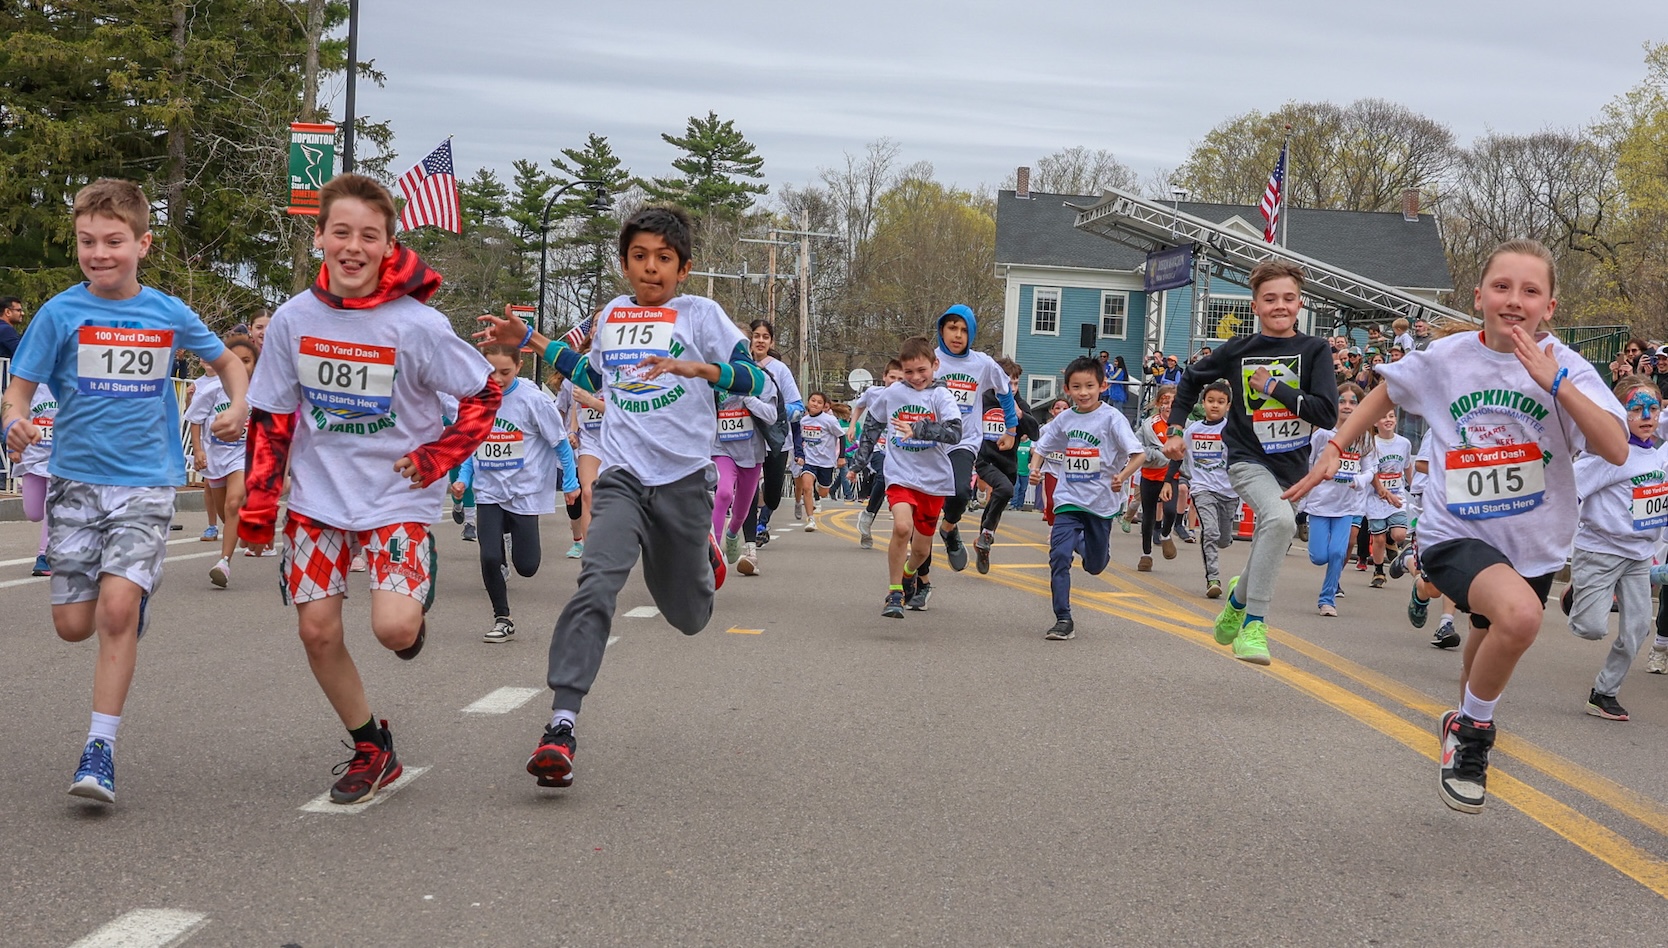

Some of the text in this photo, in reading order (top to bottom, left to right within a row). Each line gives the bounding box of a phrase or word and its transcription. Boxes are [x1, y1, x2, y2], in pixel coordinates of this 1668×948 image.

[292, 133, 334, 145] HOPKINTON
[644, 310, 662, 318] Dash
[95, 332, 161, 343] 100 Yard Dash
[616, 324, 654, 346] 115
[314, 343, 379, 358] 100 Yard Dash
[610, 352, 618, 360] All
[619, 352, 638, 360] Starts
[102, 349, 154, 375] 129
[318, 361, 368, 390] 081
[90, 381, 96, 390] It
[98, 382, 110, 390] All
[112, 382, 138, 392] Starts
[309, 391, 378, 408] It All Starts Here
[620, 399, 650, 413] YARD
[651, 384, 686, 410] DASH
[1450, 389, 1550, 422] HOPKINTON
[32, 401, 60, 414] HOPKI
[328, 422, 365, 434] YARD
[722, 419, 744, 430] 034
[987, 423, 1004, 432] 116
[1456, 407, 1545, 435] MARATHON COMMITTEE
[1268, 421, 1300, 439] 142
[1479, 425, 1506, 440] STARTS
[485, 443, 512, 457] 084
[1195, 441, 1213, 450] 047
[1460, 449, 1526, 463] 100 Yard Dash
[1067, 458, 1089, 470] 140
[1467, 467, 1524, 496] 015
[1468, 506, 1480, 514] All
[1482, 503, 1510, 513] Starts
[1513, 499, 1534, 509] Here
[1646, 496, 1668, 514] 004
[382, 564, 424, 582] LACROSSE
